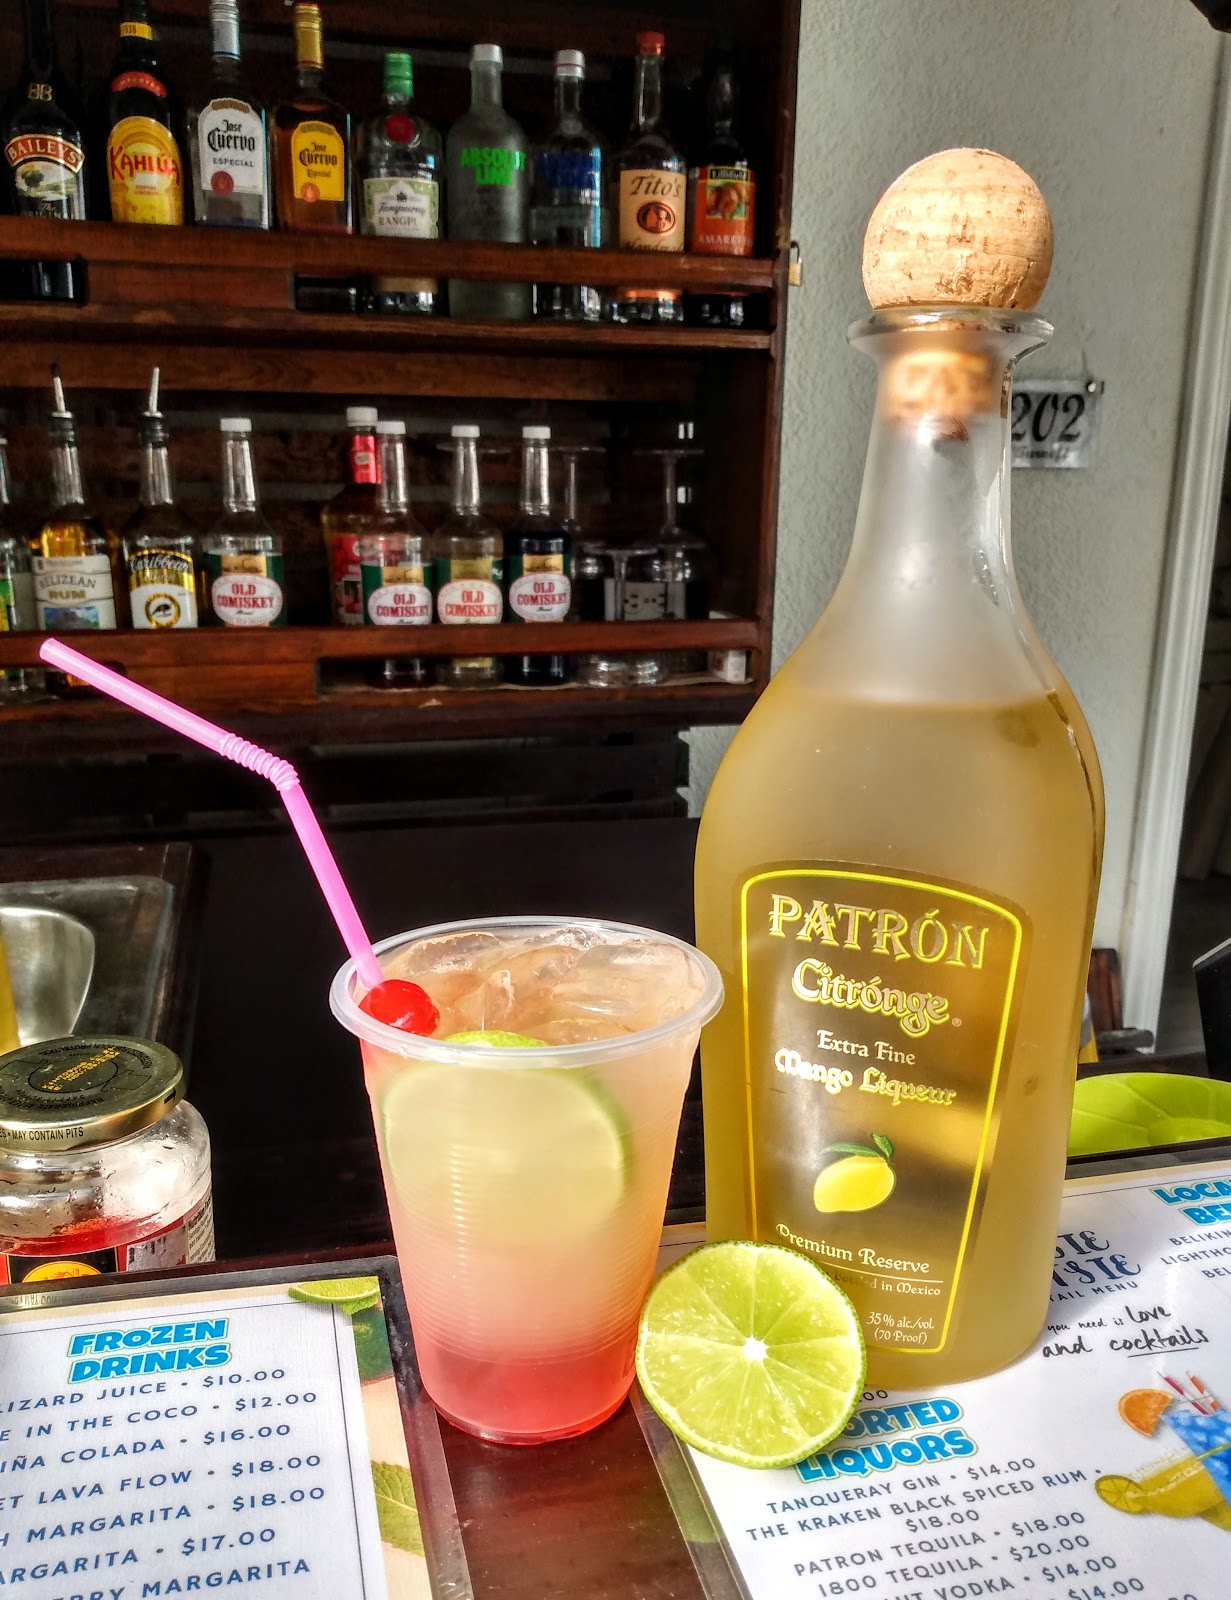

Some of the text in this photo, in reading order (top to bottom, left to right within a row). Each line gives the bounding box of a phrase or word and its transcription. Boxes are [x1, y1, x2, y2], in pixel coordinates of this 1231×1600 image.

[207, 127, 255, 152] Cuervo
[220, 119, 242, 133] Jose
[8, 137, 78, 164] BAILEYS
[213, 157, 255, 168] ESPECIAL
[299, 148, 338, 167] Cuervo
[109, 145, 181, 186] KAHLÚA
[631, 174, 682, 198] Tito's
[1012, 391, 1085, 442] 202
[130, 554, 190, 573] Caribbean
[231, 583, 256, 596] OLD
[393, 593, 416, 605] OLD
[461, 590, 485, 604] OLD
[516, 592, 567, 606] COMISKEY
[533, 581, 555, 594] OLD
[217, 596, 274, 609] COMISKEY
[376, 604, 430, 618] COMISKEY
[445, 603, 498, 617] COMISKEY
[768, 893, 989, 969] PATRÓN
[791, 957, 949, 1038] Citrónge
[817, 1029, 916, 1066] Extra Fine
[774, 1047, 956, 1106] Mango Liqueur
[12, 1130, 27, 1140] MAY
[29, 1130, 64, 1141] CONTAIN
[66, 1127, 84, 1139] PITS
[1151, 1179, 1231, 1204] LOCA
[776, 1223, 930, 1273] Premium Reserve
[881, 1280, 893, 1292] in
[896, 1282, 941, 1296] Mexico
[1091, 1280, 1138, 1295] MENU
[896, 1316, 934, 1330] alc./vol.
[1047, 1305, 1171, 1335] you need is love
[69, 1318, 228, 1355] FROZEN
[874, 1327, 928, 1345] (70 Proof)
[1042, 1325, 1209, 1358] and cocktails
[69, 1344, 230, 1382] DRINKS
[97, 1382, 167, 1400] JUICE
[203, 1369, 285, 1387] $10.00
[859, 1388, 889, 1403] .00
[26, 1423, 52, 1438] IN
[68, 1415, 113, 1432] THE
[127, 1405, 198, 1424] COCO
[235, 1392, 316, 1411] $12.00
[842, 1398, 962, 1439] ORTED
[61, 1439, 165, 1463] COLADA
[203, 1424, 290, 1445] $16.00
[797, 1429, 976, 1482] LIQUORS
[38, 1483, 104, 1505] LAVA
[120, 1470, 192, 1492] FLOW
[231, 1455, 321, 1478] $18.00
[767, 1457, 1036, 1514] TANQUERAY GIN $14.00
[27, 1505, 191, 1543] MARGARITA
[232, 1487, 325, 1512] $18.00
[746, 1469, 1088, 1541] THE KRAKEN BLACK SPICED RUM
[906, 1509, 981, 1534] $18.00
[182, 1528, 275, 1556] $17.00
[794, 1511, 1086, 1577] PATRON TEQUILA $18.00
[142, 1559, 310, 1598] MARGARITA
[818, 1534, 1090, 1598] 1800 TEQUILA $20.00
[934, 1555, 1118, 1600] VODKA $14.00
[1068, 1576, 1145, 1600] $14.00
